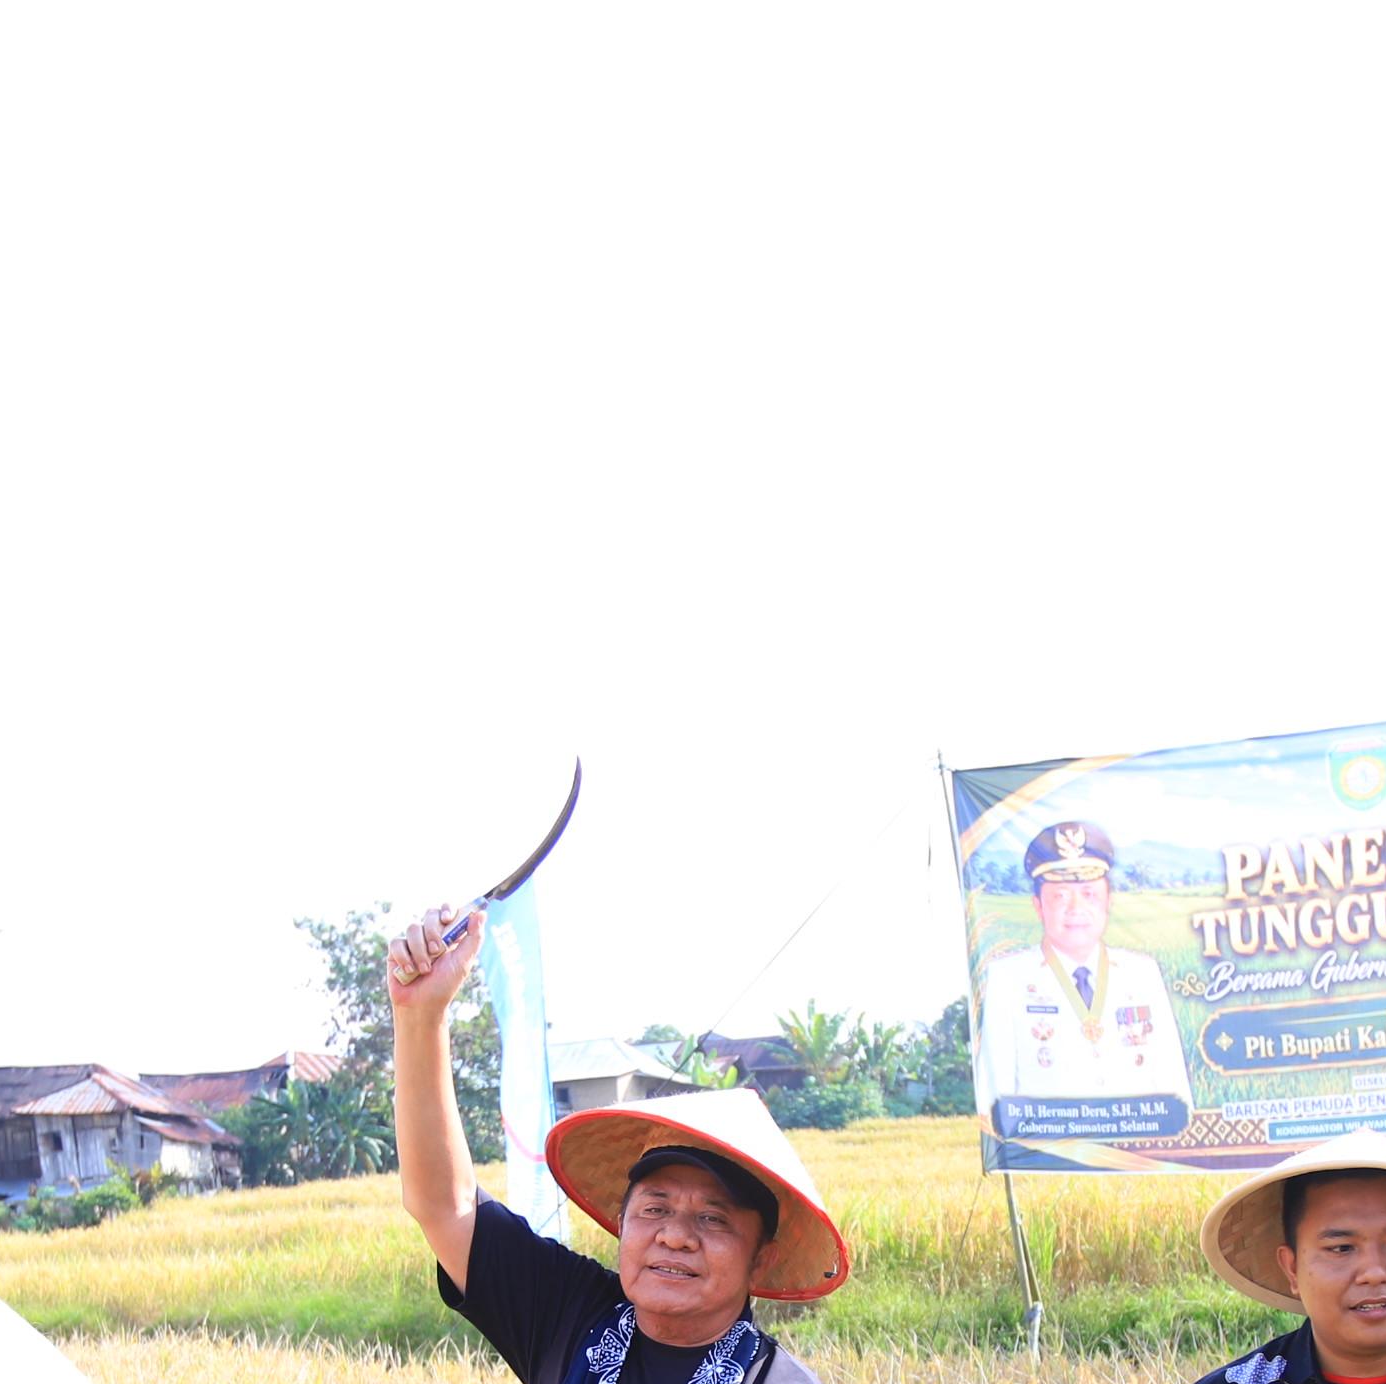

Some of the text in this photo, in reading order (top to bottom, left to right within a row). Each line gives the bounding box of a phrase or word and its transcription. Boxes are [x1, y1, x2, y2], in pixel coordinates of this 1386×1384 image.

[1204, 961, 1305, 1001] Bersama
[1244, 1034, 1275, 1058] Plt
[1281, 1027, 1351, 1059] Bupati
[1038, 1105, 1079, 1118] Herman
[1225, 1102, 1288, 1118] BARISAN
[1294, 1096, 1353, 1112] PEMUDA
[1018, 1120, 1159, 1134] Gubernur Sumatera Selatan
[1276, 1122, 1343, 1137] KOORDINATOR
